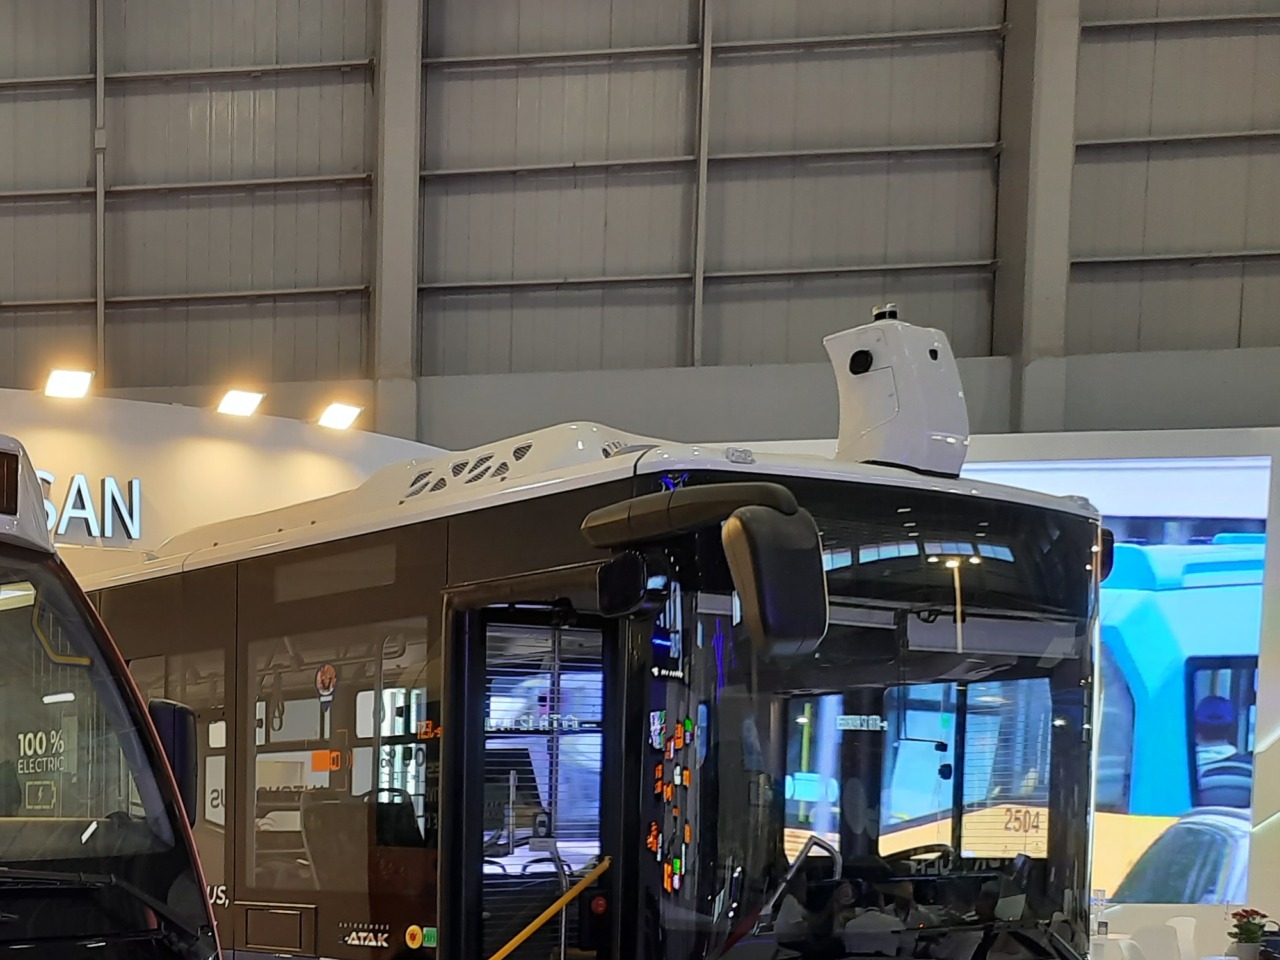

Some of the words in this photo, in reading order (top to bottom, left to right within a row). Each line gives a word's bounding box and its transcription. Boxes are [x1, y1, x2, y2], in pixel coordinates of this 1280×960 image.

[18, 731, 47, 757] 100
[50, 729, 65, 754] %
[18, 756, 65, 774] ELECTRIC
[1003, 807, 1041, 834] 2504
